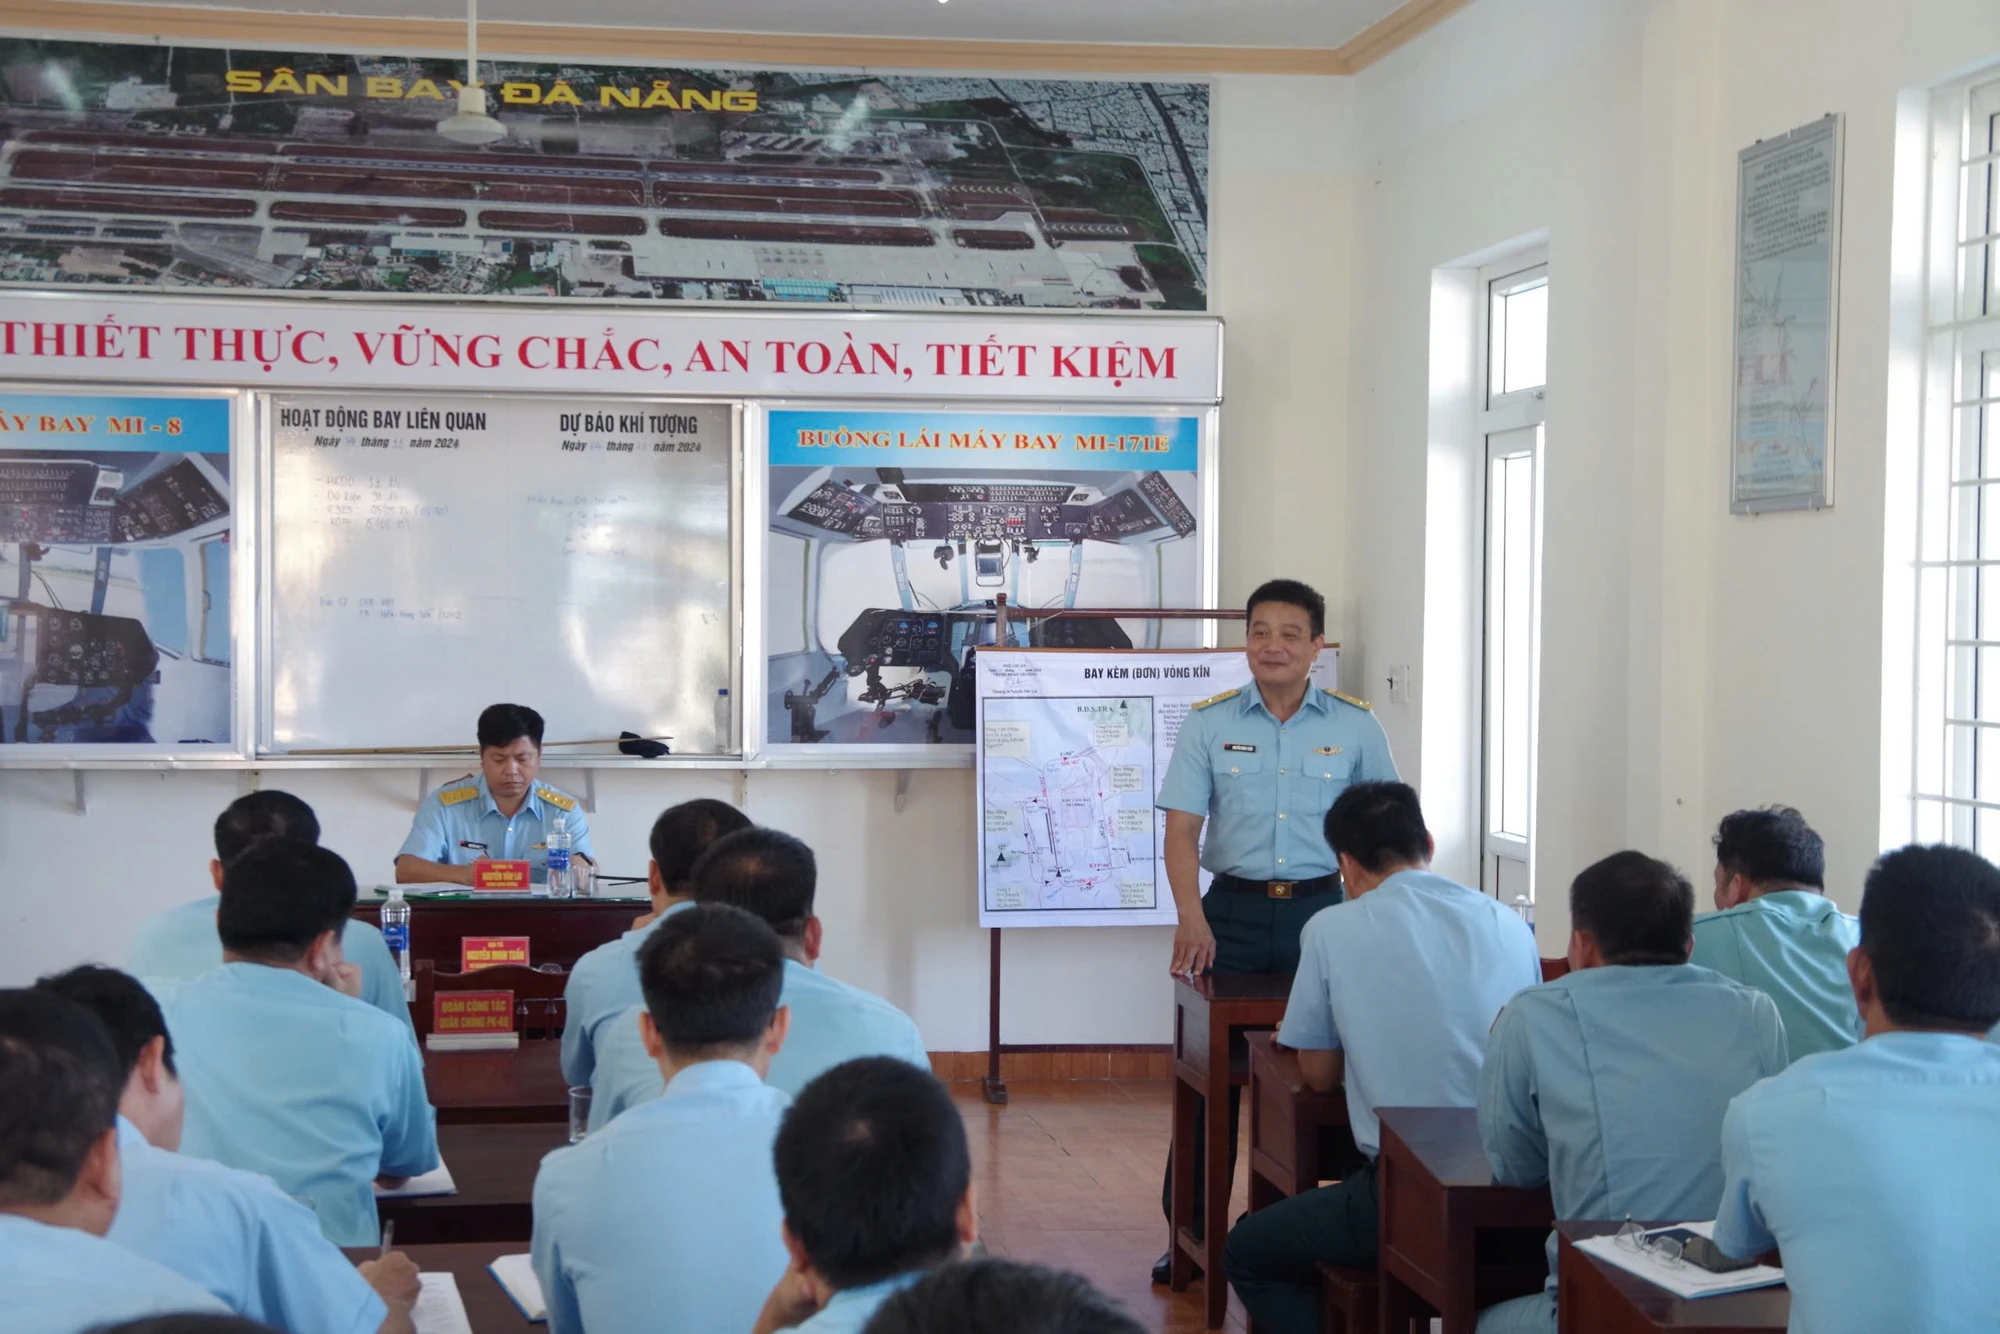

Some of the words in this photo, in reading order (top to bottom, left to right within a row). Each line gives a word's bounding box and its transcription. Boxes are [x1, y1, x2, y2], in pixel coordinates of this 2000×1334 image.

[225, 67, 348, 97] SÂN
[500, 80, 584, 107] ĐÀ
[599, 80, 758, 113] NẴNG
[0, 314, 161, 360] THIẾT
[174, 324, 339, 372] THỰC,
[352, 324, 503, 368] VỮNG
[518, 327, 673, 379] CHẮC,
[683, 339, 752, 374] AN
[765, 331, 913, 382] TOÀN,
[926, 333, 1037, 377] TIẾT
[1050, 340, 1179, 388] KIỆM
[39, 415, 95, 434] BAY
[107, 416, 146, 435] MI
[166, 416, 183, 436] 8
[280, 408, 321, 432] HOẠT
[325, 406, 368, 432] ĐỘNG
[373, 410, 402, 429] BAY
[407, 407, 441, 430] LIÊN
[445, 411, 487, 432] QUAN
[559, 412, 582, 436] DỰ
[584, 410, 614, 433] BÁO
[619, 411, 645, 433] KHÍ
[649, 413, 698, 438] TƯỢNG
[314, 435, 341, 449] Ngày
[361, 436, 390, 449] tháng
[434, 437, 460, 449] 2024
[561, 439, 588, 452] Ngày
[606, 440, 634, 453] tháng
[677, 441, 702, 452] 2024
[898, 428, 941, 449] LÁI
[949, 427, 1007, 449] MÁY
[1013, 432, 1063, 451] BAY
[1074, 433, 1170, 453] MI-171E
[1084, 668, 1104, 679] BAY
[1107, 665, 1129, 679] KÈM
[1132, 666, 1160, 680] (ĐƠN)
[1163, 664, 1190, 679] VÒNG
[1193, 664, 1211, 678] KÍN
[491, 998, 507, 1012] TÁC
